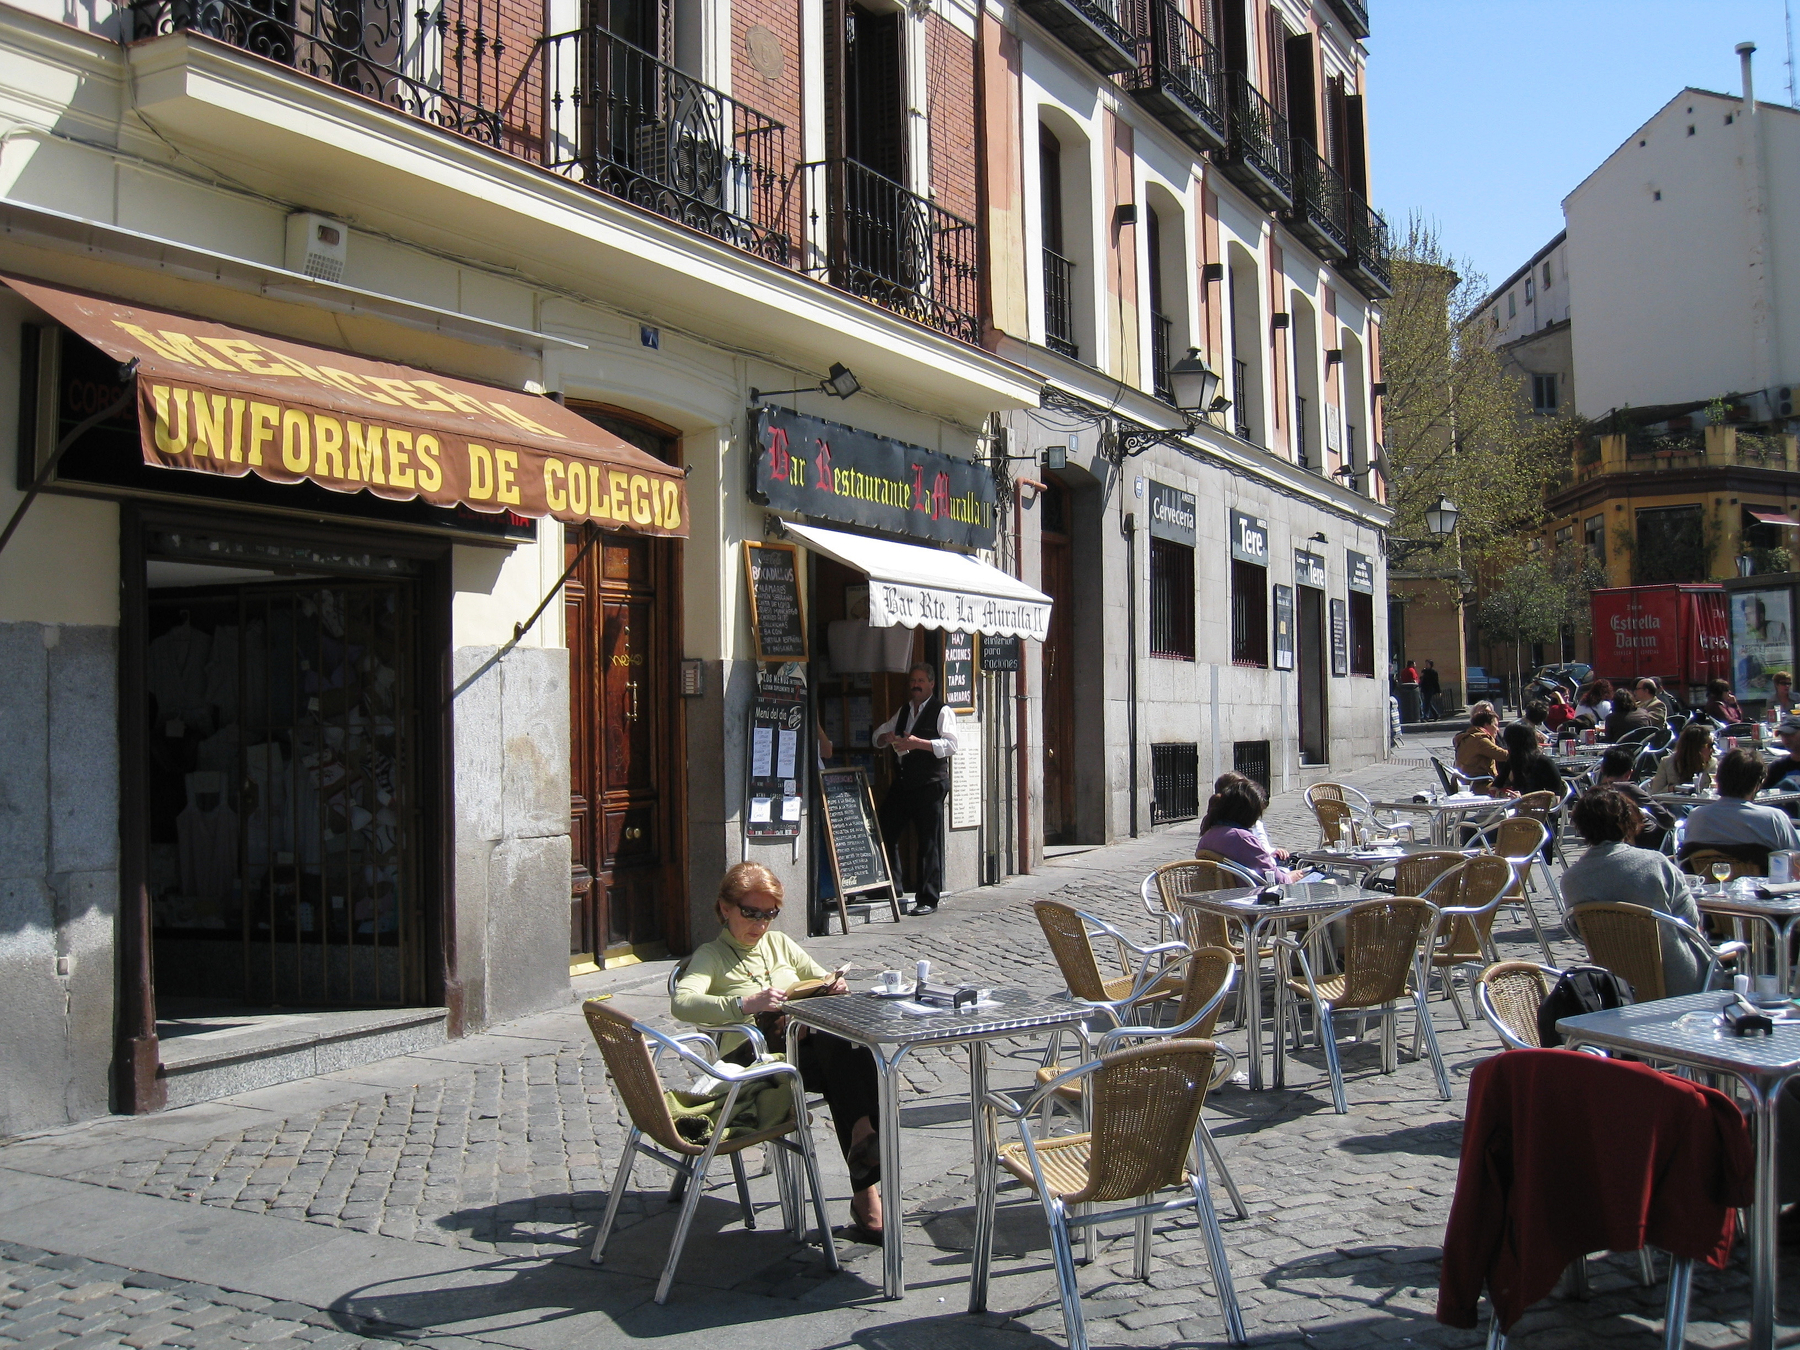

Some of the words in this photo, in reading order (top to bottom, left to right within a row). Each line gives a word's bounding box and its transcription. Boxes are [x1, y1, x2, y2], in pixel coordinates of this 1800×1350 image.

[152, 384, 442, 492] UNIFORMES
[468, 443, 521, 505] DE
[543, 456, 682, 530] COLEGIO
[768, 425, 806, 487] Bar
[815, 438, 911, 511] Restaurante
[911, 463, 931, 515] La
[931, 471, 981, 525] Muralla
[1153, 496, 1194, 530] Cervecería
[1239, 517, 1263, 557] Tere
[1309, 558, 1325, 587] Tere
[883, 586, 913, 617] Bar
[919, 591, 950, 621] Rte.
[955, 595, 975, 624] La
[982, 600, 1032, 630] Muralla
[1610, 614, 1661, 631] Estrella
[951, 633, 965, 646] HAY
[945, 648, 971, 662] RACIONES
[955, 662, 960, 674] Y
[947, 674, 966, 687] TAPAS
[946, 689, 971, 703] VARIADAS
[755, 706, 770, 719] Menú
[770, 707, 779, 720] del
